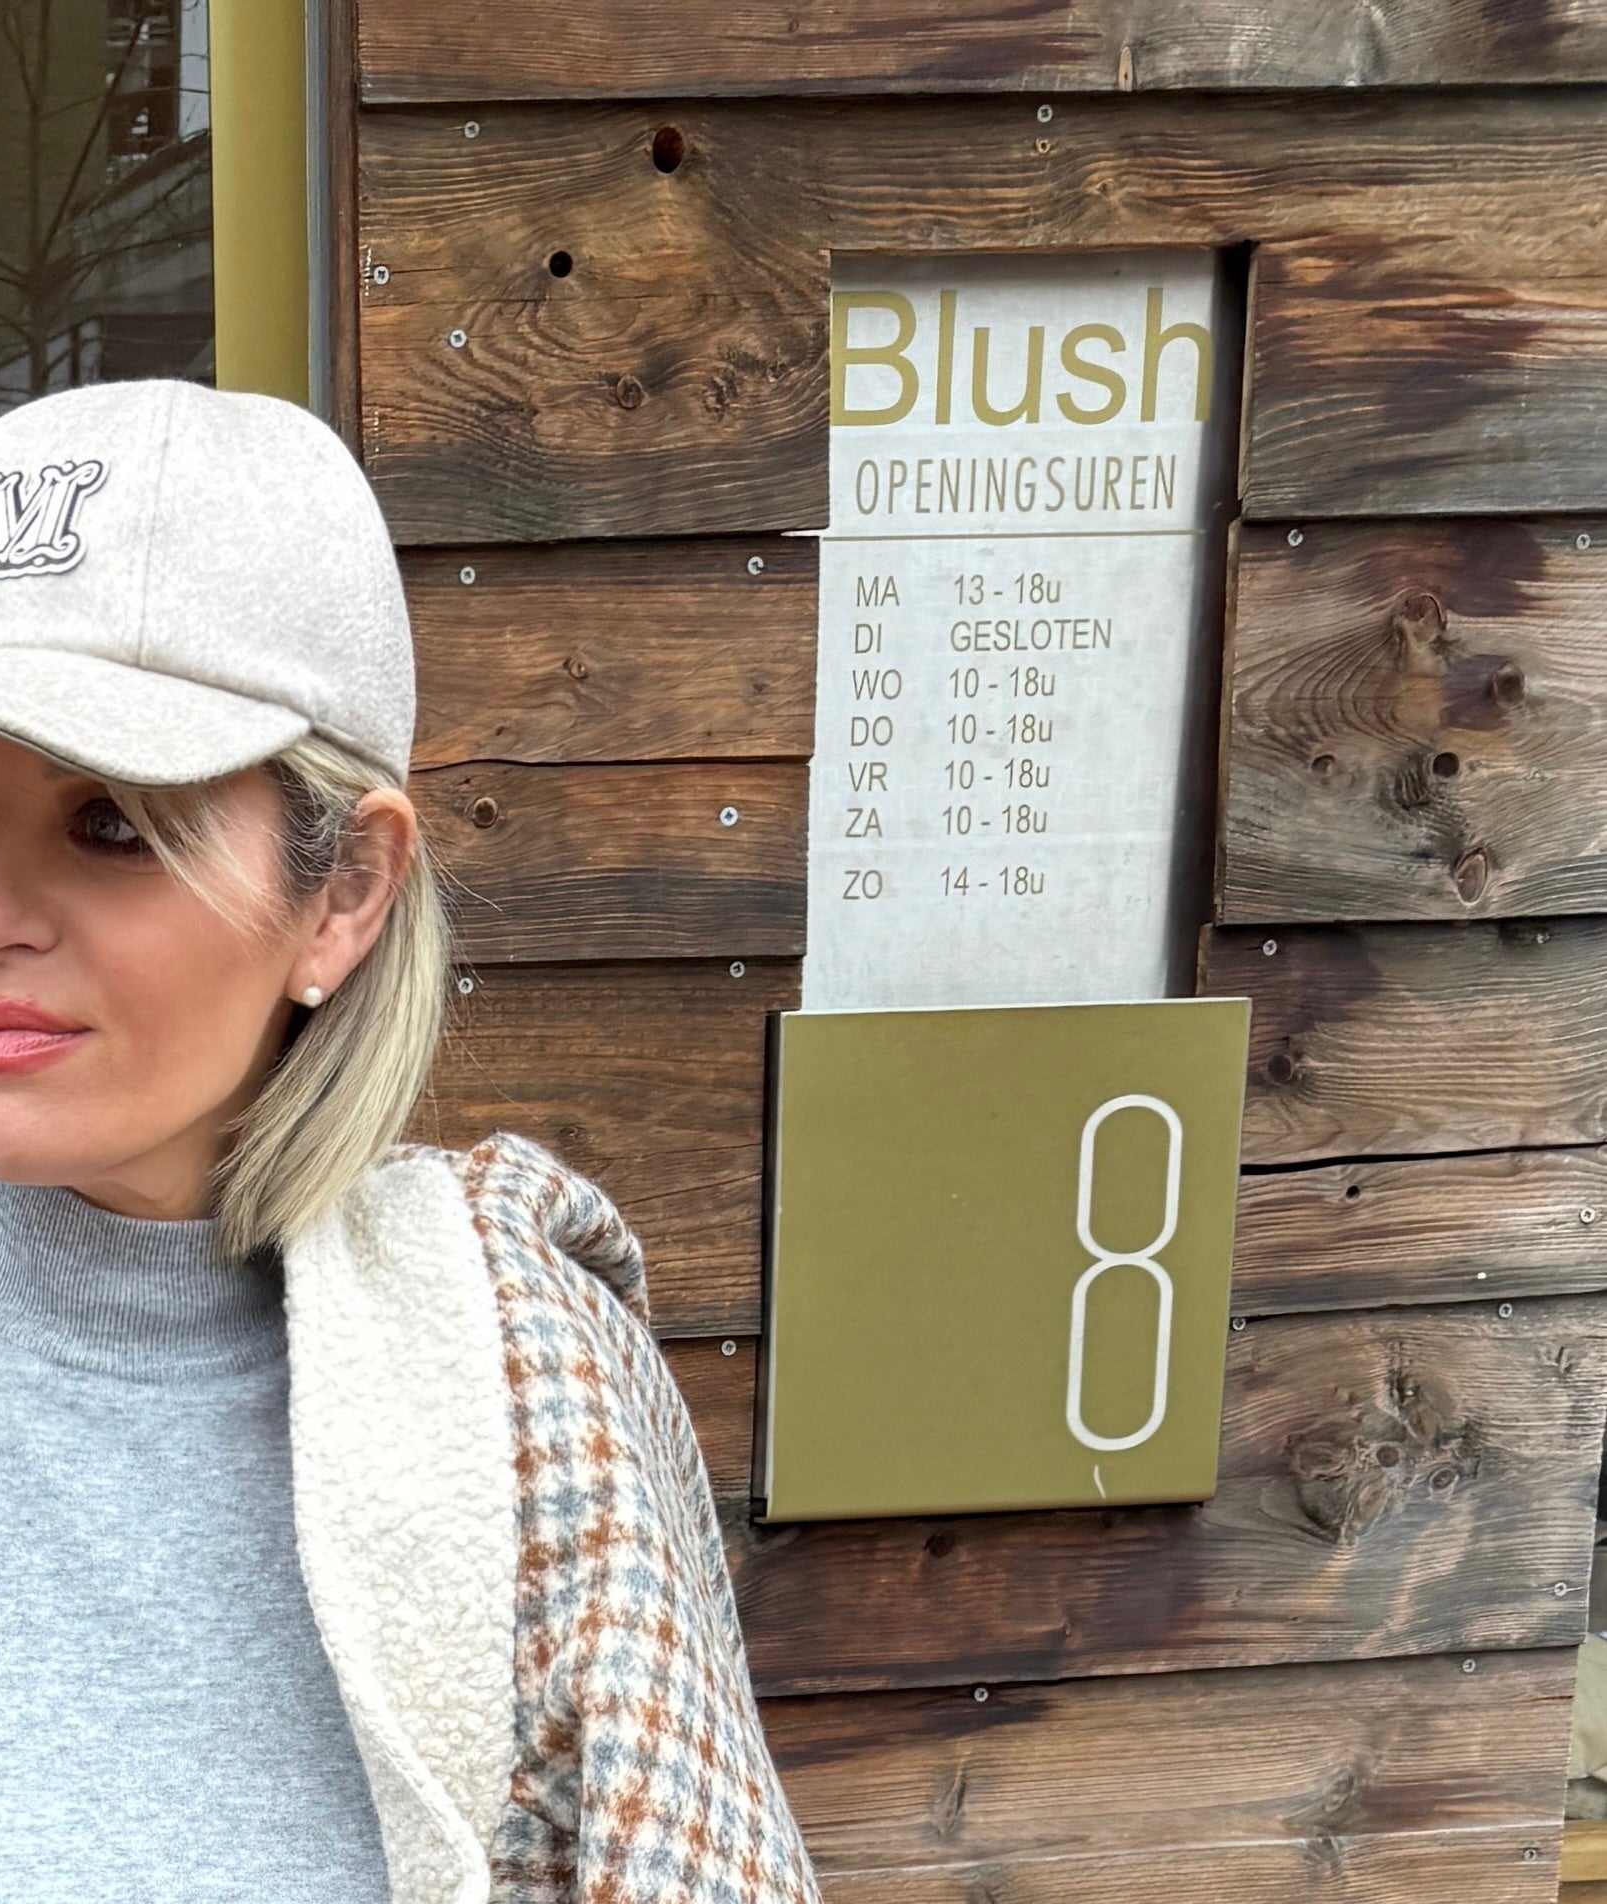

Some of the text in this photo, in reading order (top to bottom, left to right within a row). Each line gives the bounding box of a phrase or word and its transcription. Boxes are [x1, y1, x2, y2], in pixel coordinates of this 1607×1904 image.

[829, 286, 1214, 427] Blush
[855, 454, 1177, 516] OPENINGSUREN
[856, 575, 900, 607] MA
[954, 574, 984, 605] 13
[1014, 573, 1062, 604] 18u
[854, 618, 1112, 654] DI GESLOTEN
[852, 669, 902, 700] WO
[949, 667, 979, 698] 10
[1009, 667, 1056, 697] 18u
[851, 715, 893, 747] DO
[947, 714, 977, 744] 10
[1007, 713, 1053, 744] 18u
[848, 762, 888, 792] VR
[944, 760, 975, 790] 10
[1004, 758, 1050, 789] 18u
[845, 807, 883, 838] ZA
[942, 805, 972, 835] 10
[1001, 804, 1047, 834] 18u
[842, 869, 884, 900] ZO
[940, 866, 970, 896] 14
[999, 866, 1044, 896] 18u
[1066, 1094, 1183, 1451] 8
